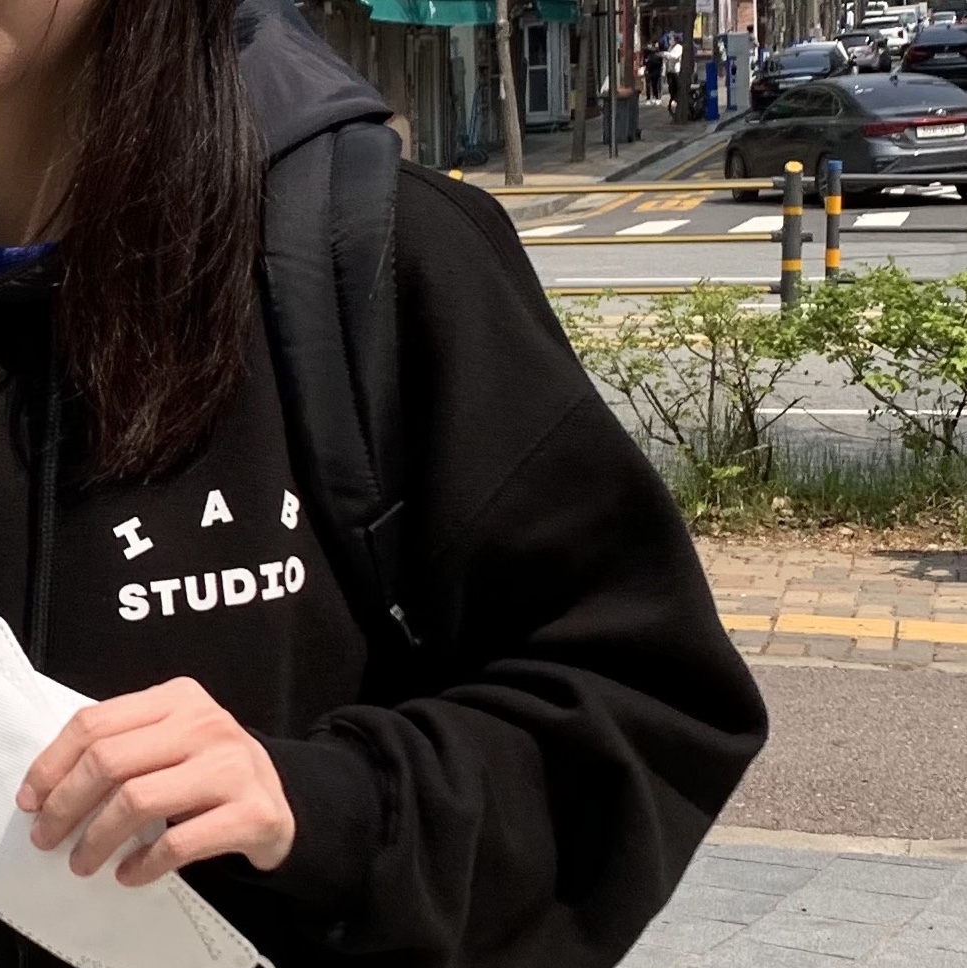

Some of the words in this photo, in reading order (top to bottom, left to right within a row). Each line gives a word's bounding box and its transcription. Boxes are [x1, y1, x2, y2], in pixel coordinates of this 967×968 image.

[113, 516, 154, 560] I
[201, 489, 233, 527] A
[281, 489, 300, 530] B
[118, 555, 305, 621] STUDIO
